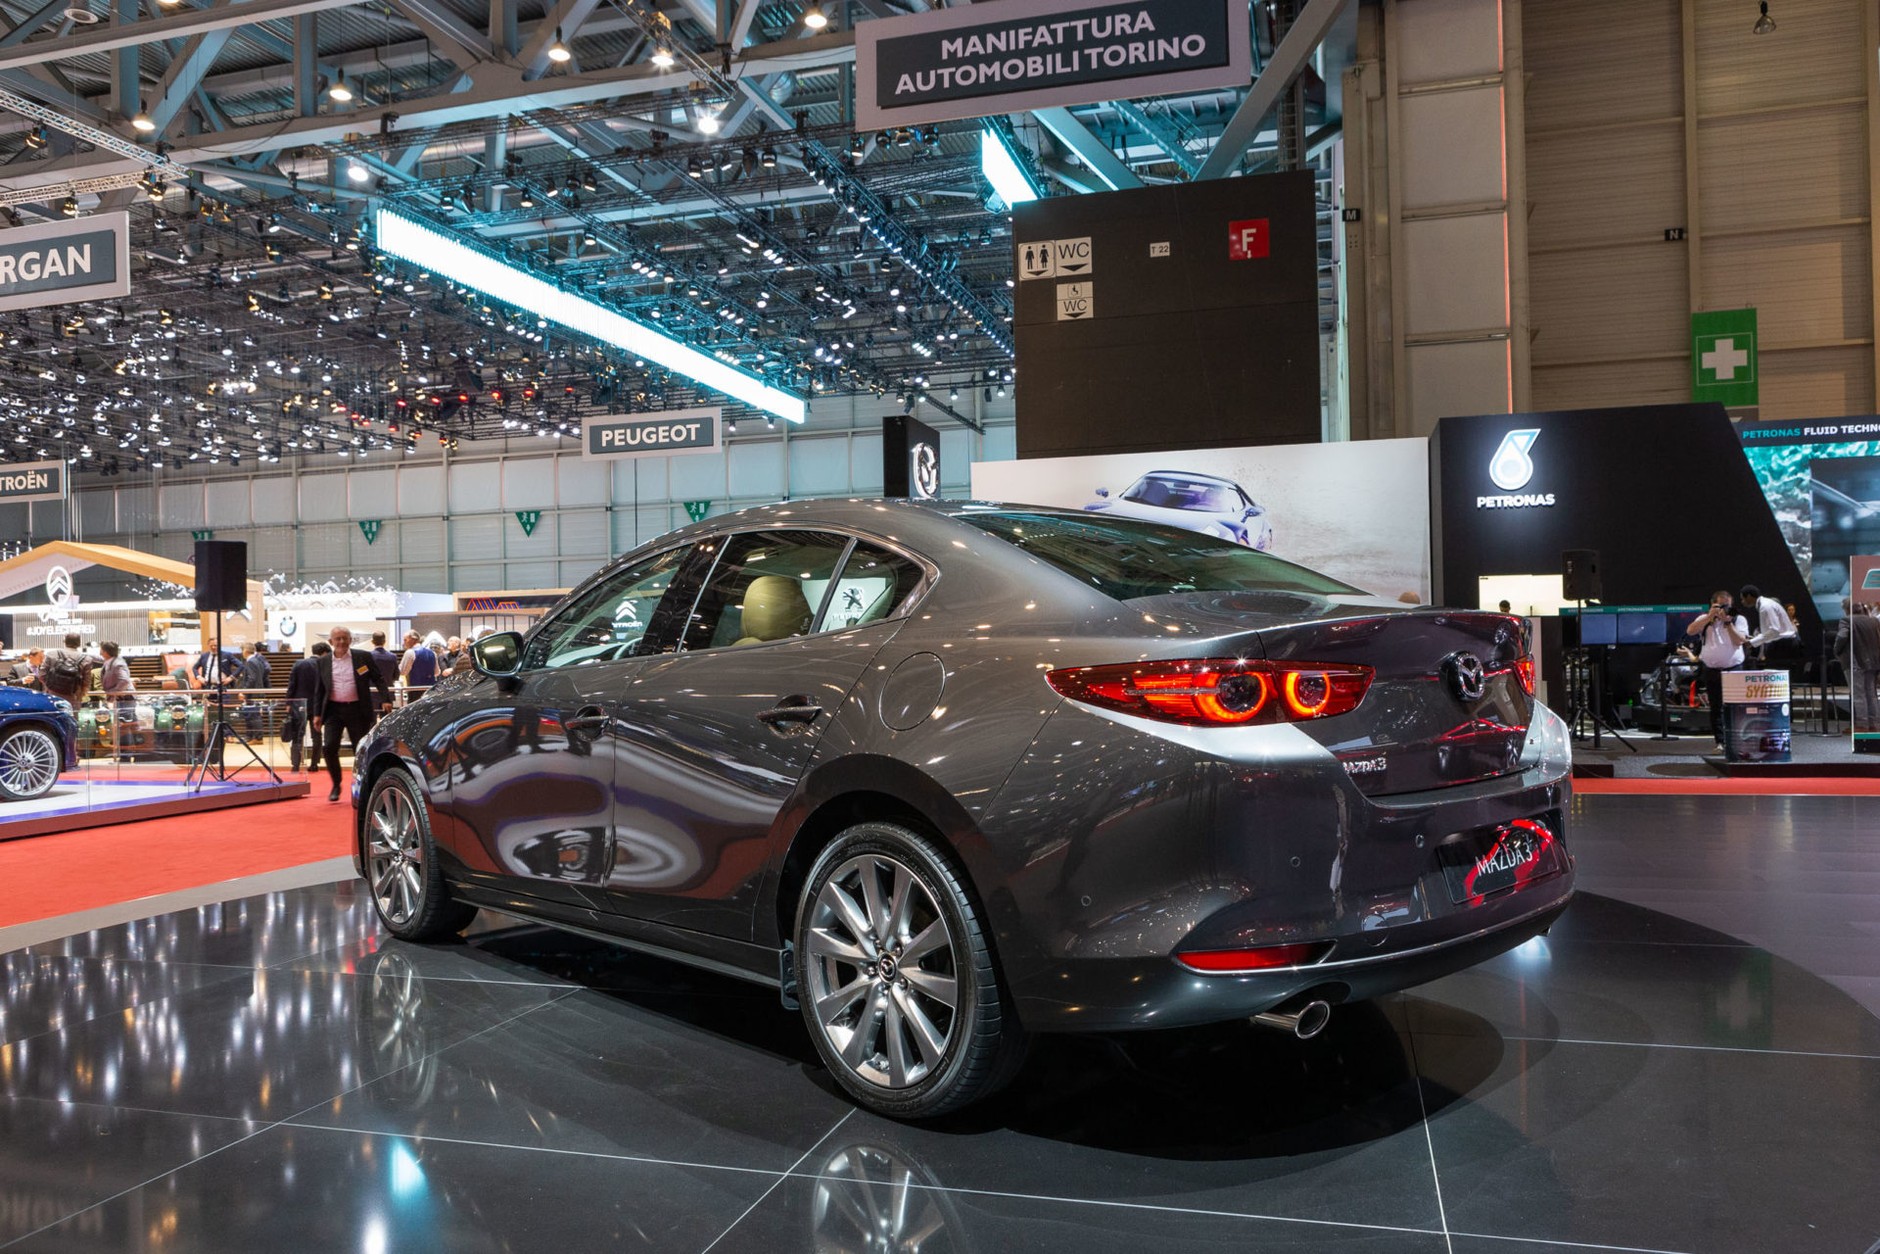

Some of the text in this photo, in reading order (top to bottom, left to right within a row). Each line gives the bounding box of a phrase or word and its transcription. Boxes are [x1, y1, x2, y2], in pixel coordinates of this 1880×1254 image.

[941, 11, 1155, 60] MANIFATTURA
[895, 34, 1206, 95] AUTOMOBILI TORINO
[1346, 210, 1356, 220] M
[1242, 228, 1257, 252] F
[1670, 229, 1679, 240] N
[1058, 242, 1089, 259] WC
[1159, 245, 1169, 254] 22
[1063, 299, 1087, 312] WC
[601, 423, 700, 447] PEUGEOT
[1742, 423, 1880, 439] PETRONAS FLUID TECHN
[1477, 493, 1555, 509] PETRONAS
[1475, 841, 1533, 877] MAZDA3
